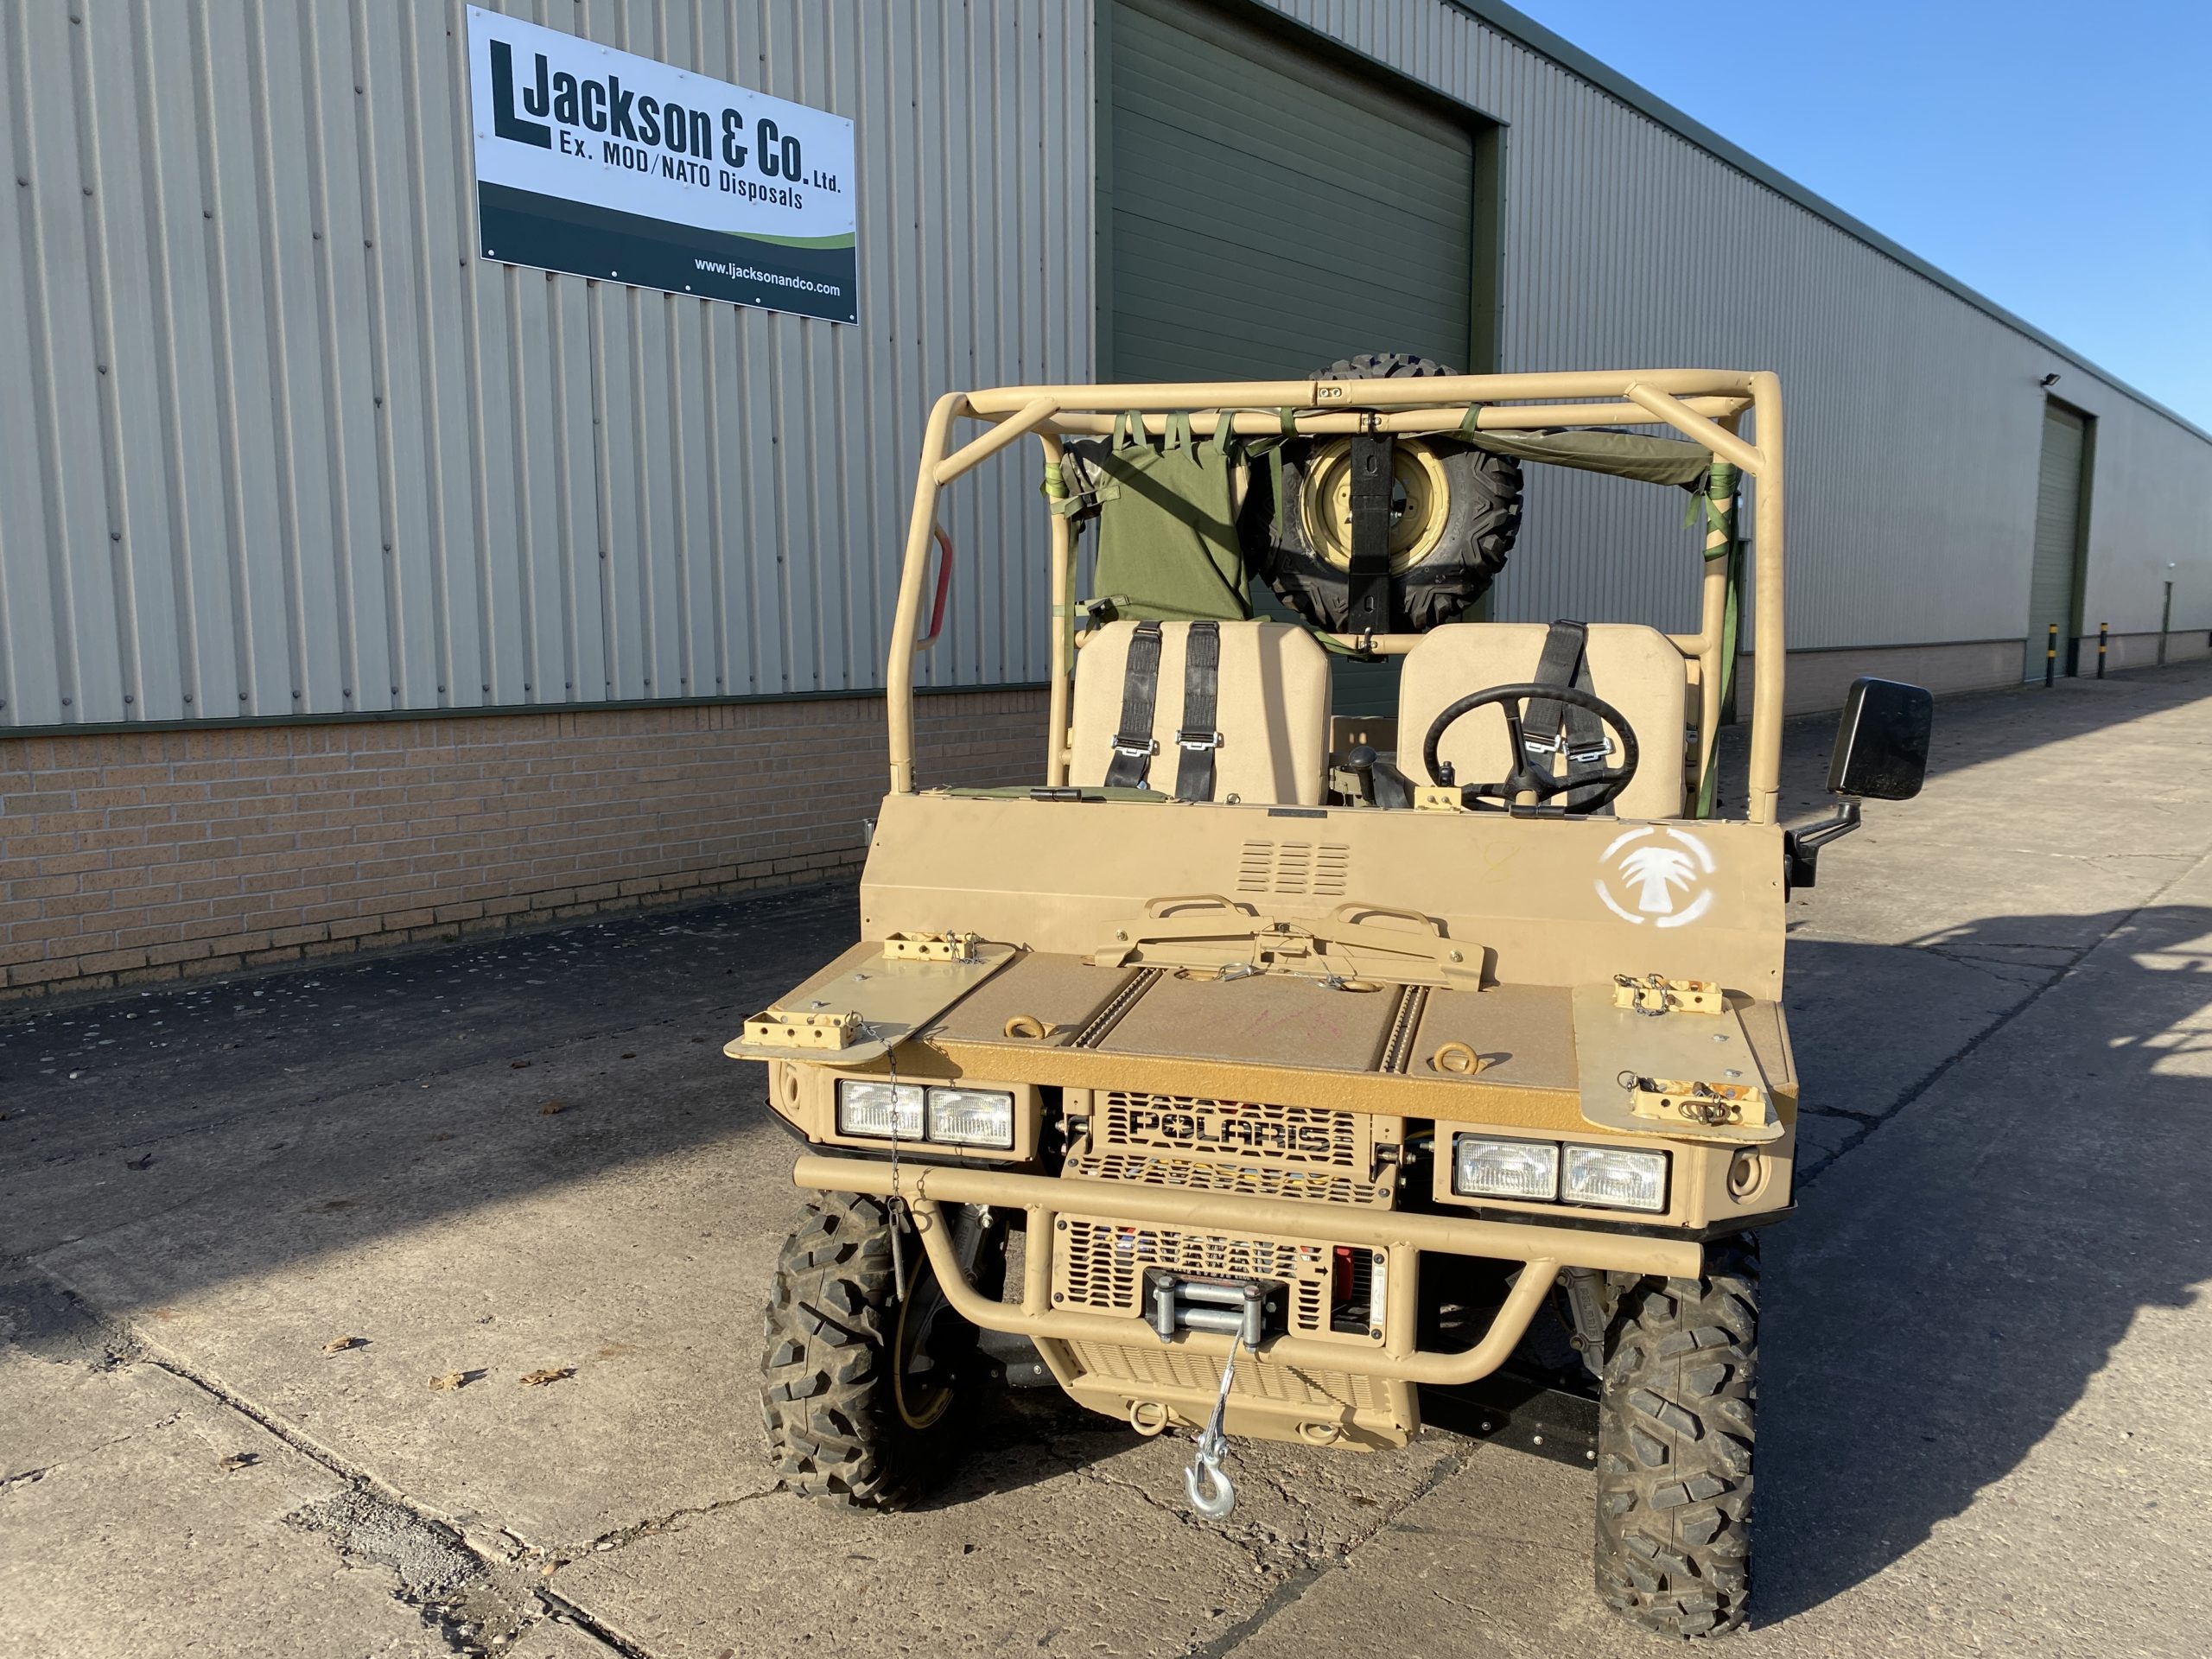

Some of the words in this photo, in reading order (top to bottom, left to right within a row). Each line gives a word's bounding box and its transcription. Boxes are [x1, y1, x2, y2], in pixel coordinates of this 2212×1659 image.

[559, 129, 593, 160] Ex.
[602, 140, 710, 188] MOD/NATO
[719, 169, 803, 209] Disposals
[721, 108, 748, 168] &
[757, 118, 810, 186] Co.
[813, 169, 842, 194] Ltd.
[694, 258, 841, 296] www.ljacksonandco.com
[1128, 1109, 1332, 1153] POLARIS
